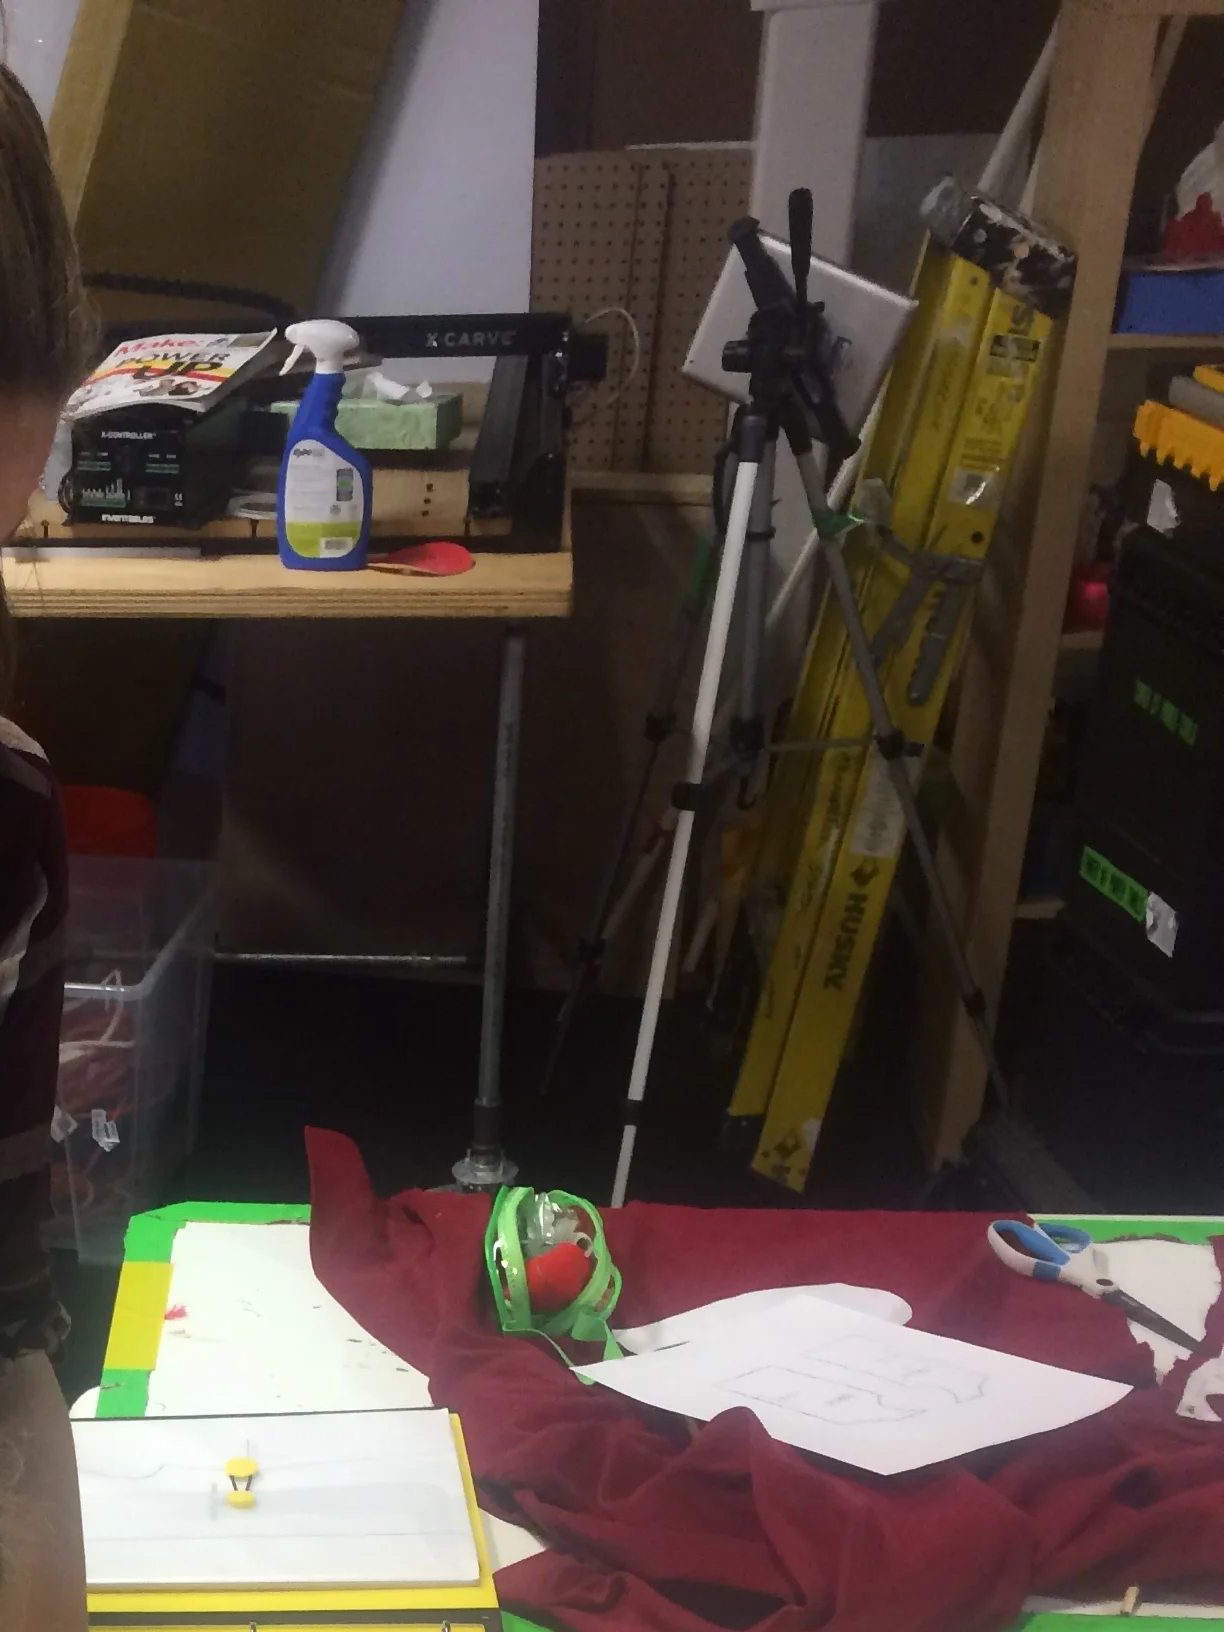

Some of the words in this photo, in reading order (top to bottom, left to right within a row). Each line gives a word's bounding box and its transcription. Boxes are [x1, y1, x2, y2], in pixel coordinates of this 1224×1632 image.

[116, 351, 230, 369] POWER
[132, 360, 224, 380] UP
[823, 893, 868, 992] HUSKY
